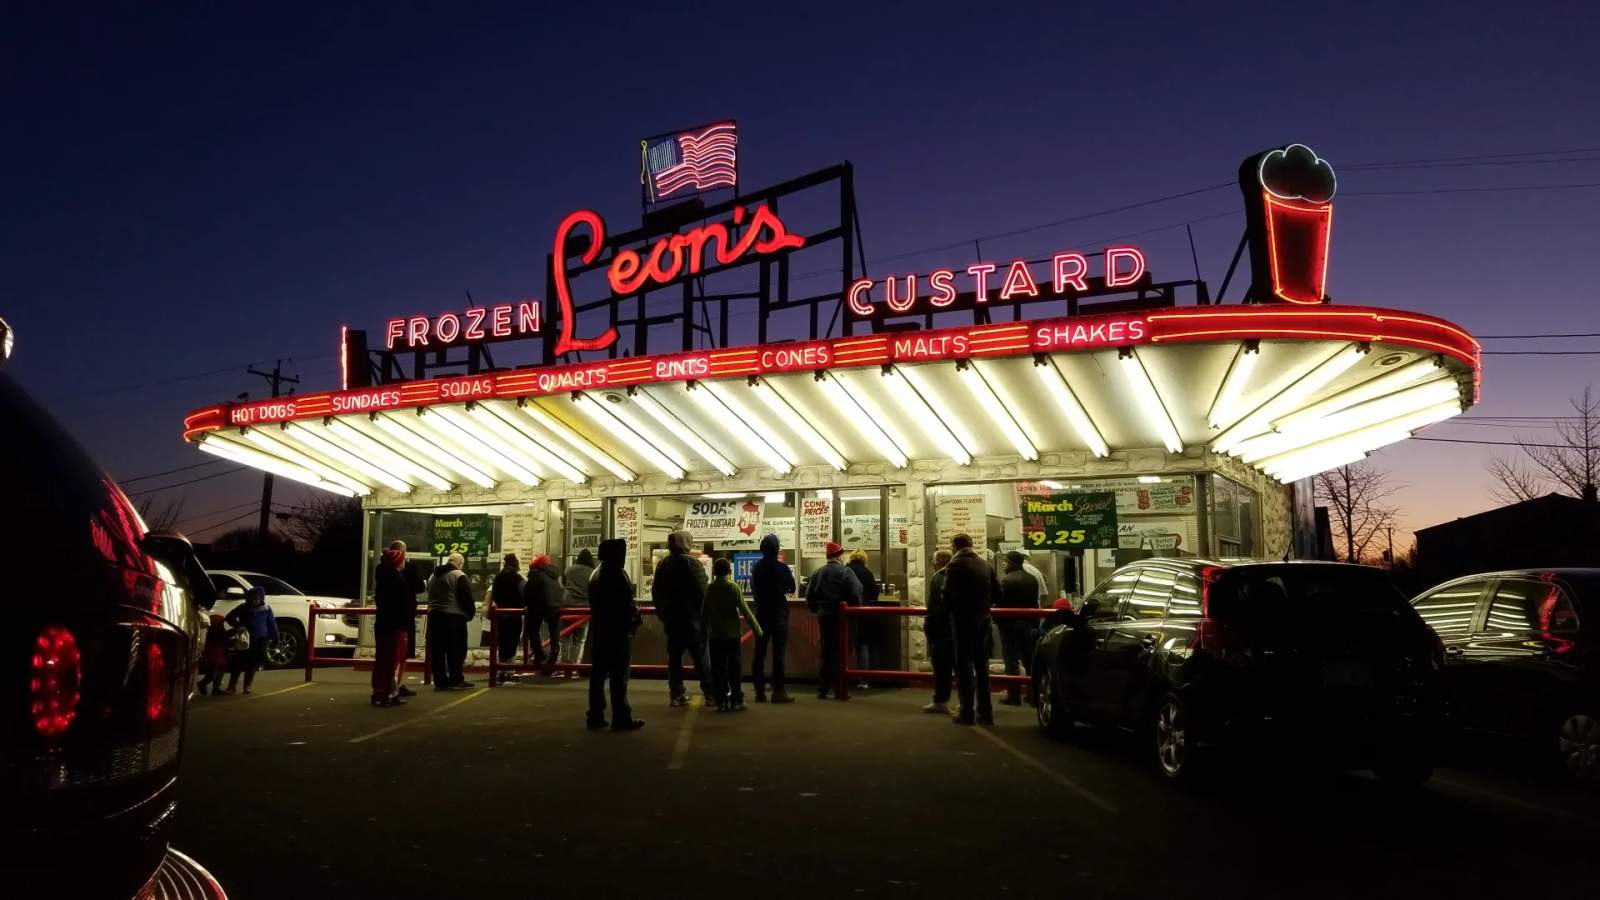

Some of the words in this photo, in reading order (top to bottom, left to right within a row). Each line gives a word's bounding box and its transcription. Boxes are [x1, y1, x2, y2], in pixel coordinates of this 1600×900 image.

[553, 203, 806, 356] Leon's
[848, 245, 1146, 316] CUSTARD
[387, 301, 542, 349] FROZEN
[1035, 319, 1146, 348] SHAKES
[760, 345, 829, 369] CONES
[893, 334, 970, 360] MALTS
[655, 356, 709, 379] PINTS
[439, 380, 493, 400] SODAS
[537, 367, 608, 393] QUARTS
[331, 391, 401, 412] SUNDAES
[230, 407, 257, 423] HOT
[258, 403, 296, 421] DOGS
[616, 506, 637, 514] CONE
[692, 501, 737, 515] SODAS
[803, 500, 826, 508] CONE
[803, 507, 829, 517] PRICES
[1027, 499, 1073, 513] March
[434, 518, 463, 528] March
[686, 518, 710, 529] FROZEN
[710, 517, 736, 528] CUSTARD
